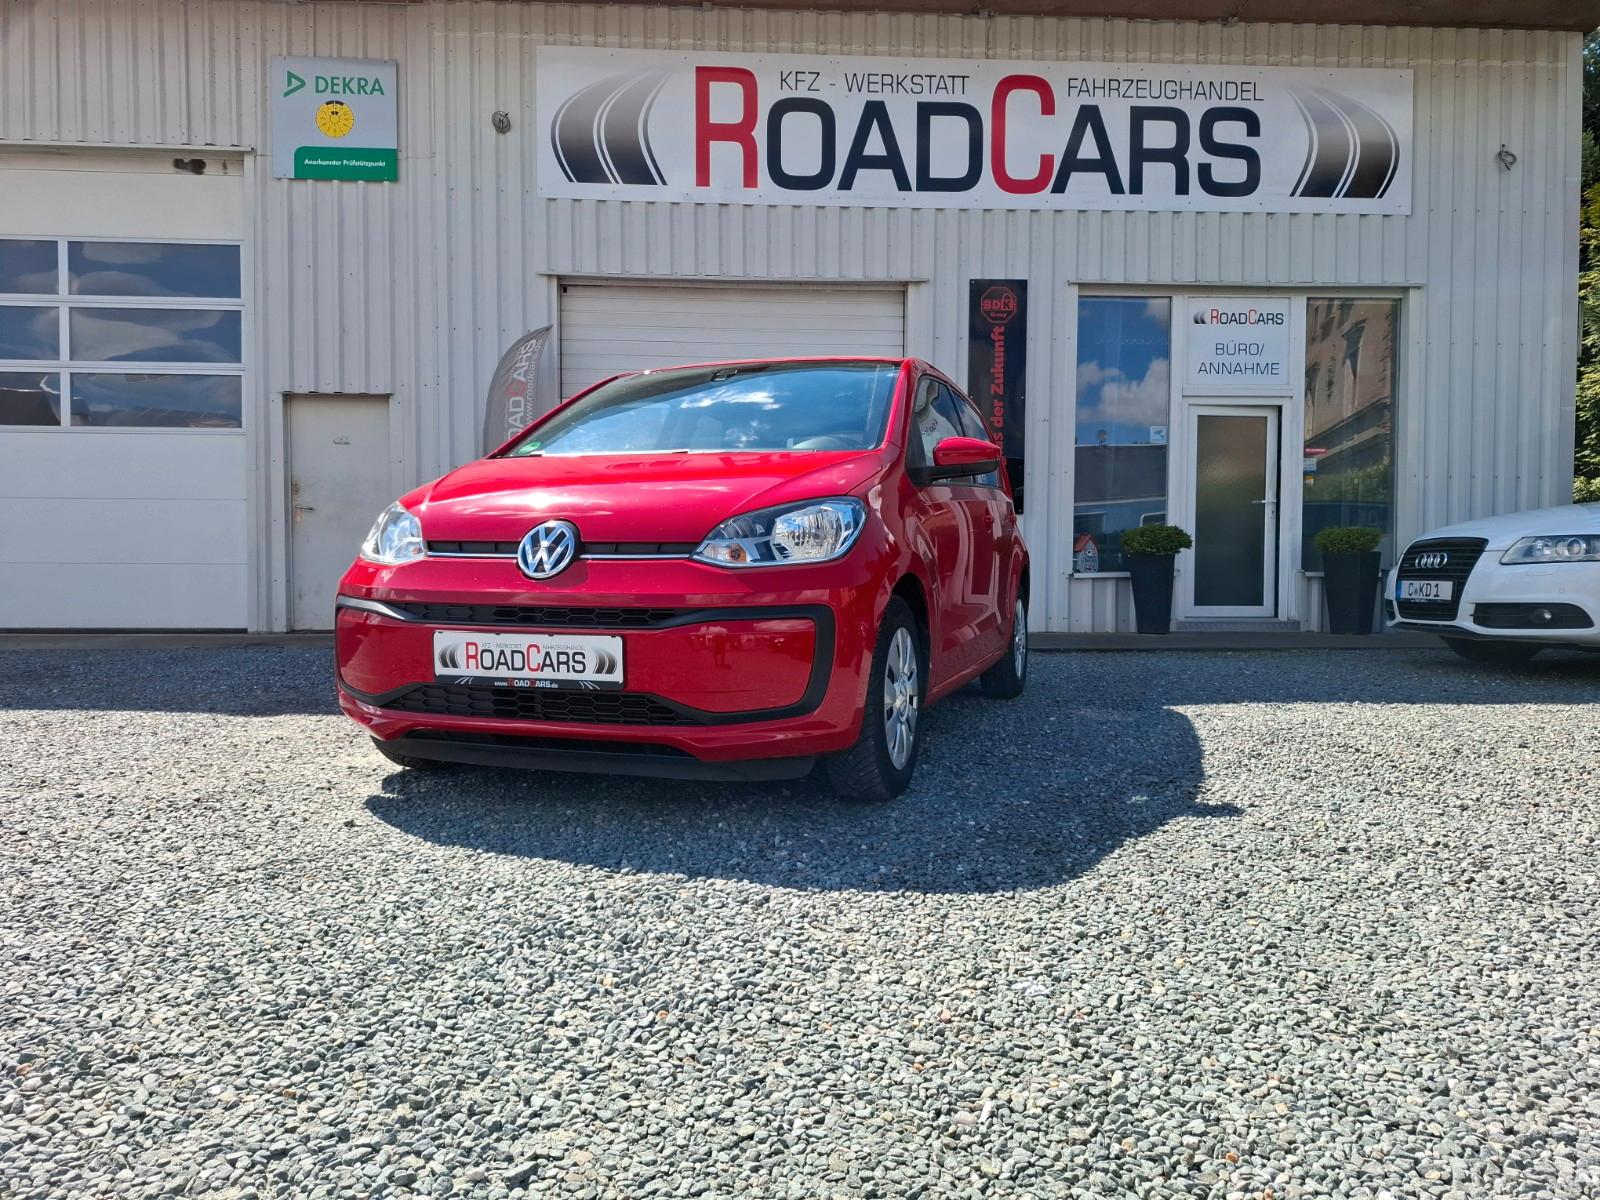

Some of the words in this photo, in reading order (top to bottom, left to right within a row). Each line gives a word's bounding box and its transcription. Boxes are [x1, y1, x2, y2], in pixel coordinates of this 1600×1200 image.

[314, 75, 385, 96] DEKRA
[779, 70, 821, 92] KFZ
[844, 72, 970, 95] WERKSTATT
[1067, 77, 1264, 102] FAHRZEUGHANDEL
[990, 325, 1005, 394] Zukunft
[1215, 340, 1264, 357] BÜRO/
[1198, 362, 1280, 375] ANNAHME
[991, 400, 1004, 428] der
